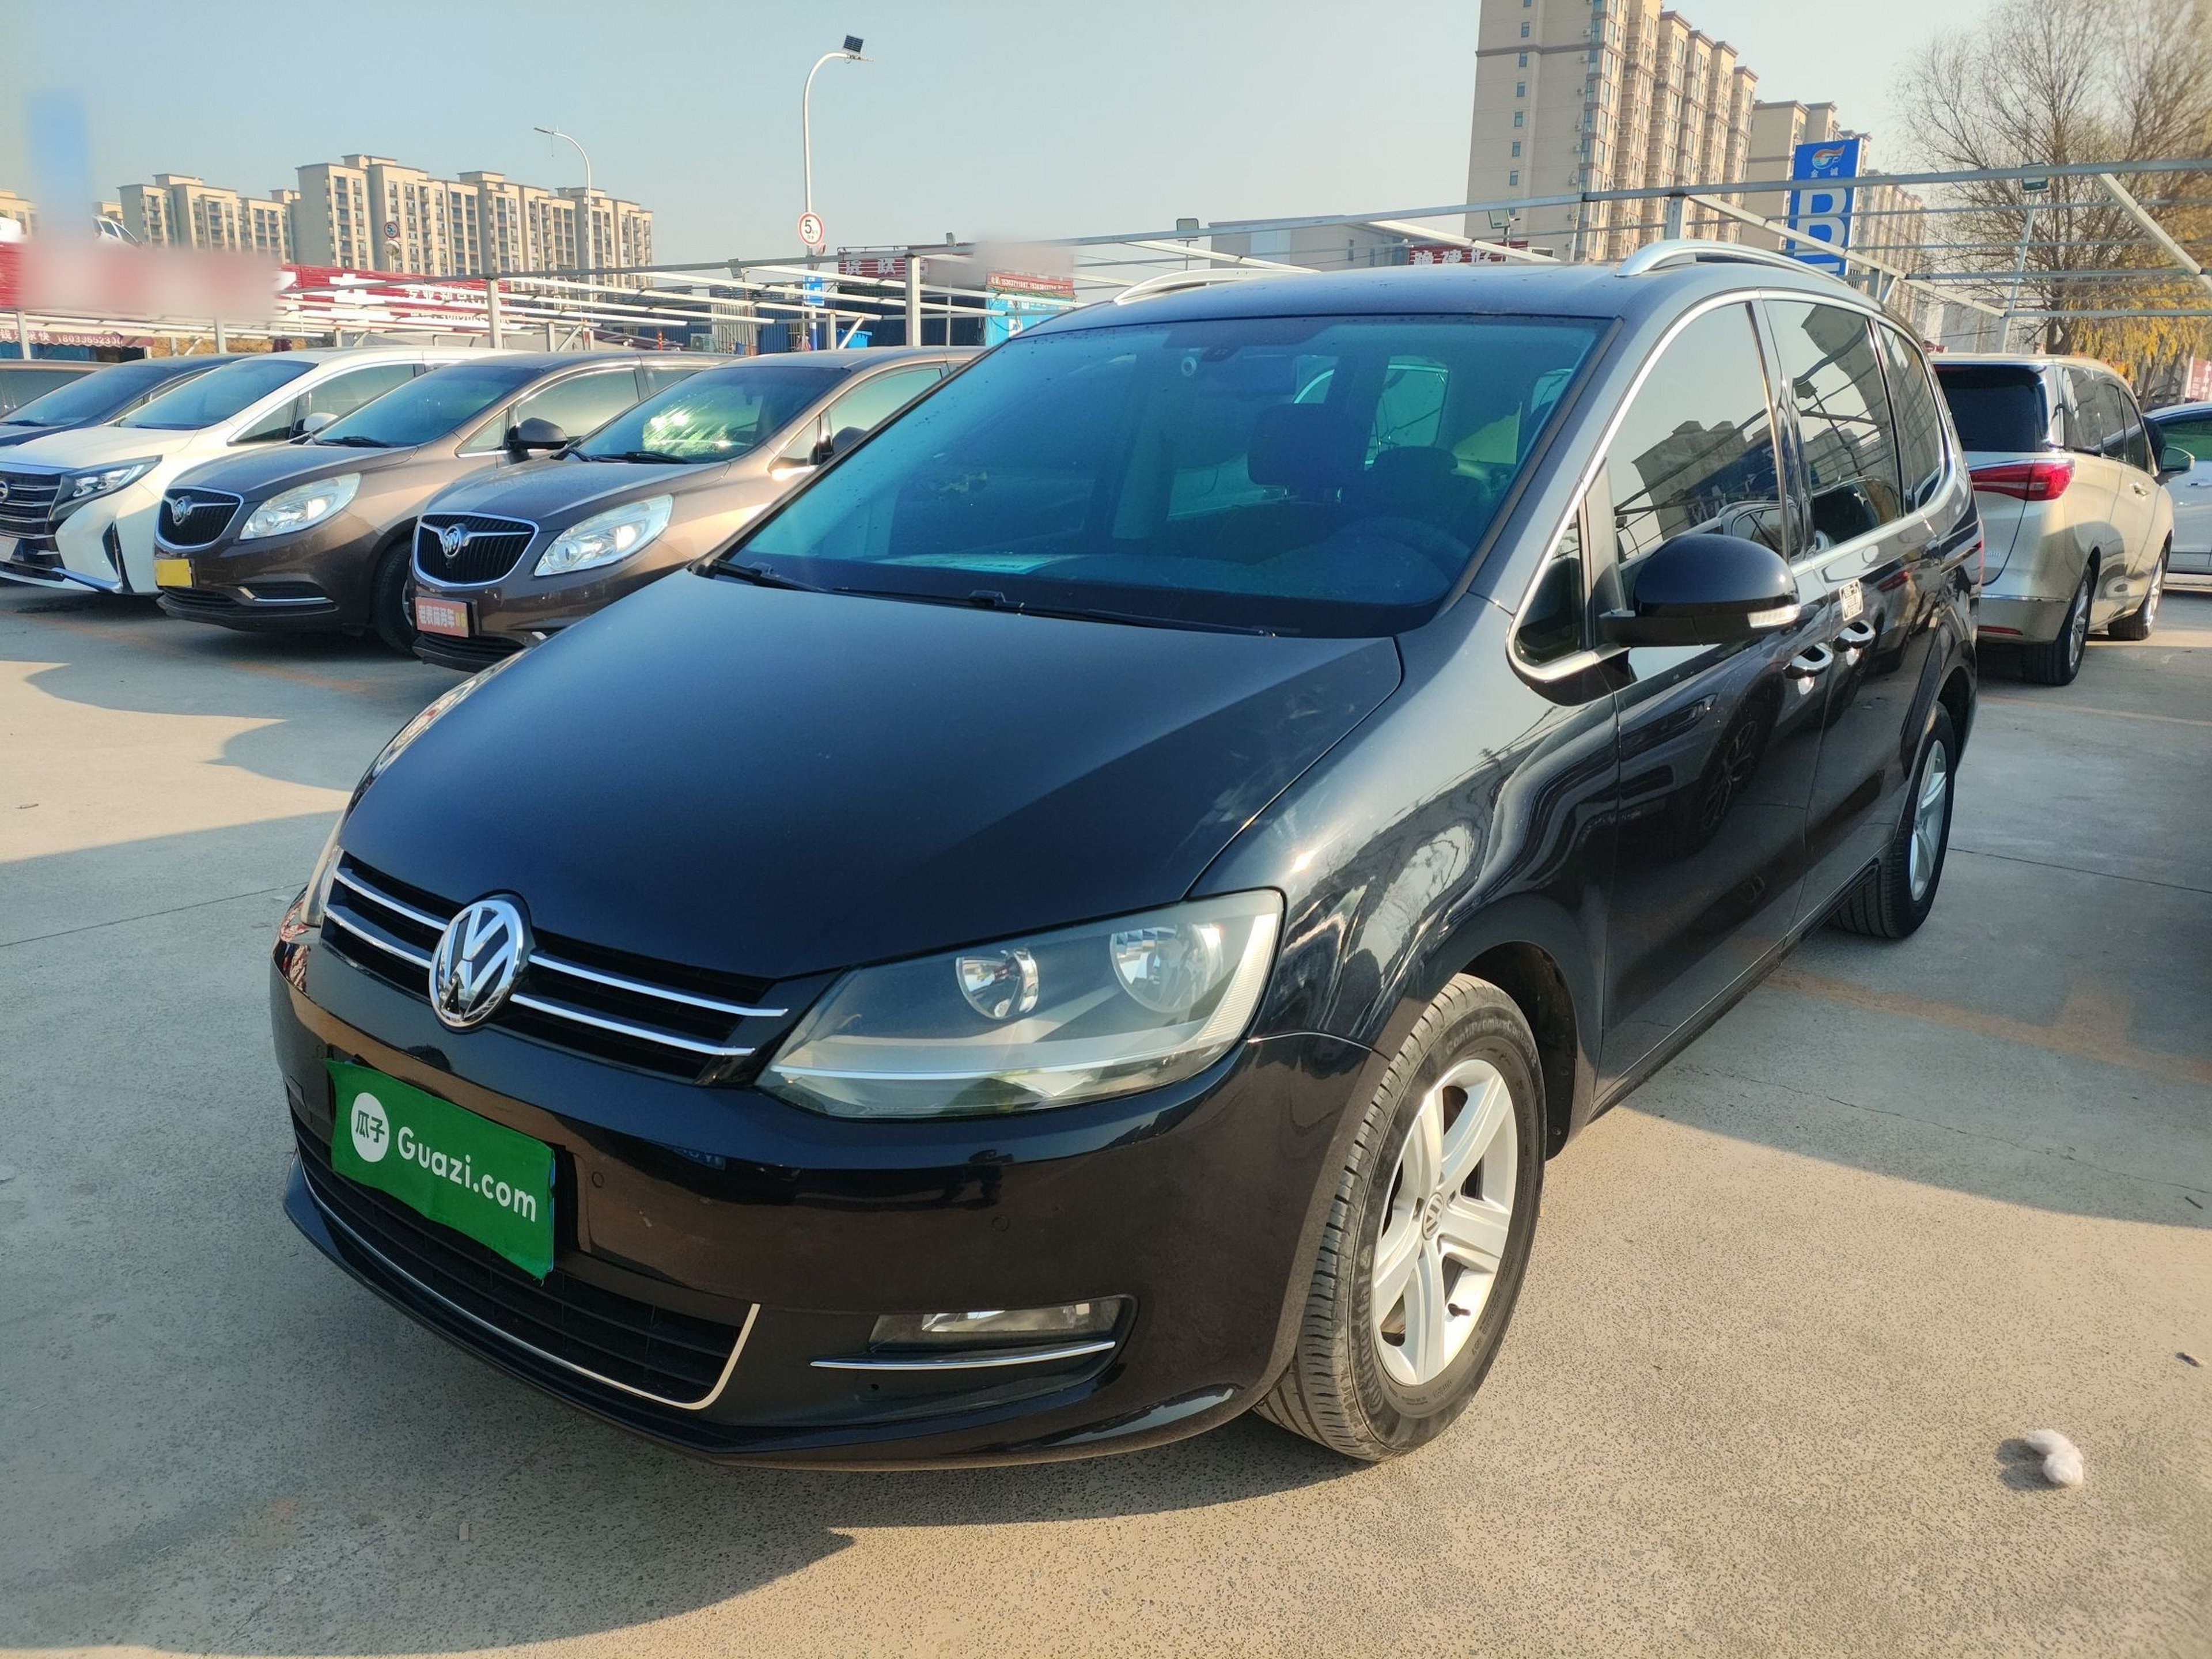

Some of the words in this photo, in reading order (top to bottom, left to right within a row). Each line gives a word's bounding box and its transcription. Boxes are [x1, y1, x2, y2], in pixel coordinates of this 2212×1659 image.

[805, 219, 812, 234] 5
[355, 1109, 385, 1143] 瓜子
[397, 1126, 537, 1222] Guazi.com
